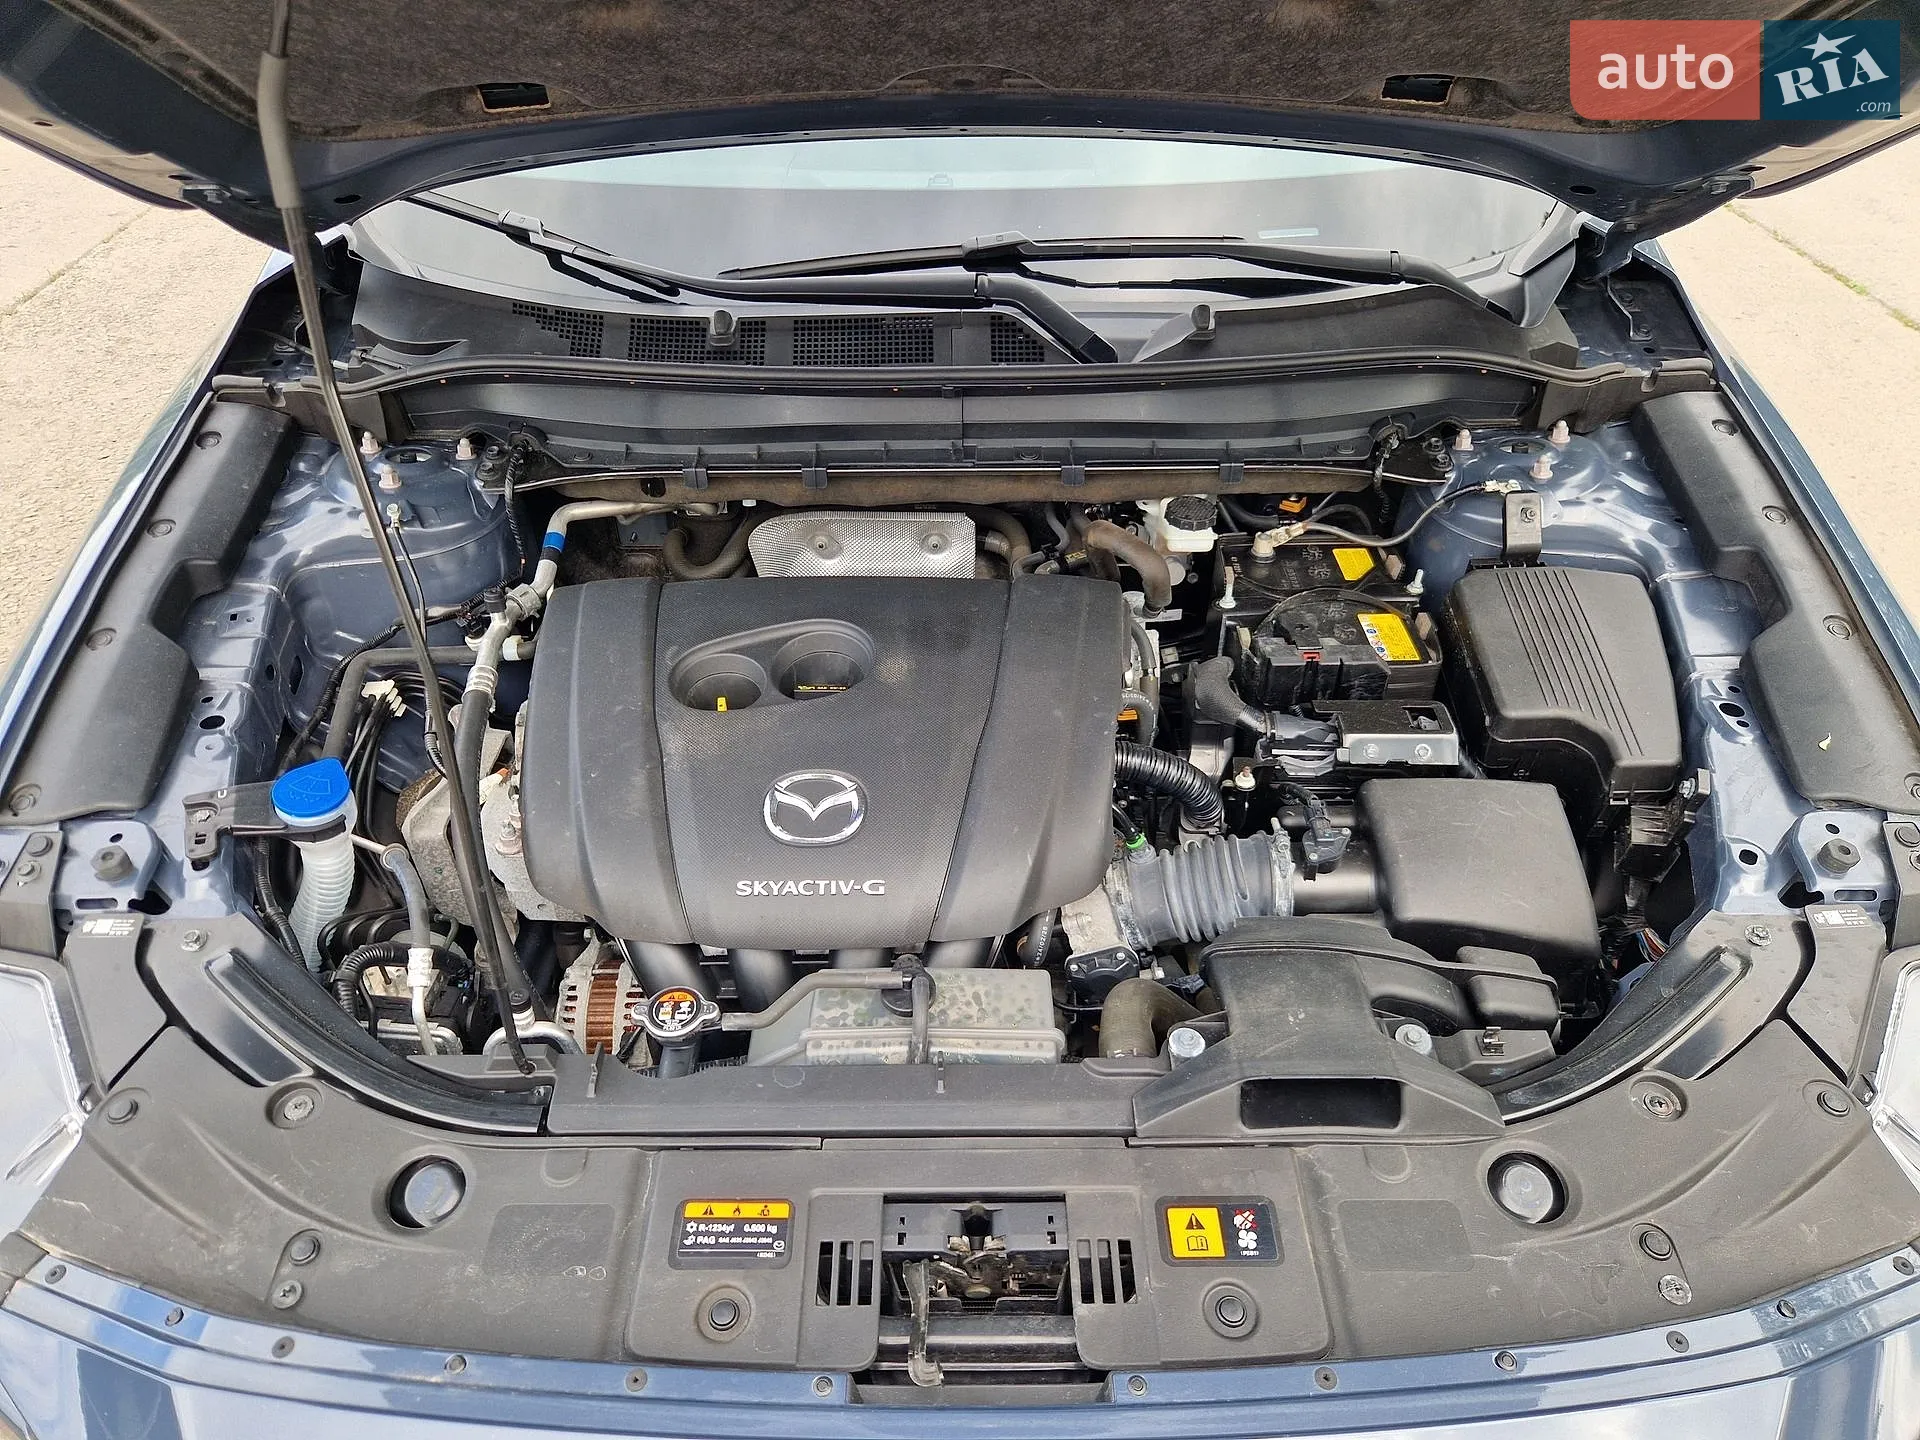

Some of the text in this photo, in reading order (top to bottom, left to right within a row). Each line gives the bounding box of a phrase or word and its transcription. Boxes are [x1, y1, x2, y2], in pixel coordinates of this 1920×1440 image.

[735, 879, 886, 897] SKYACTIV-G
[766, 1223, 778, 1234] kg
[696, 1235, 716, 1245] PAG
